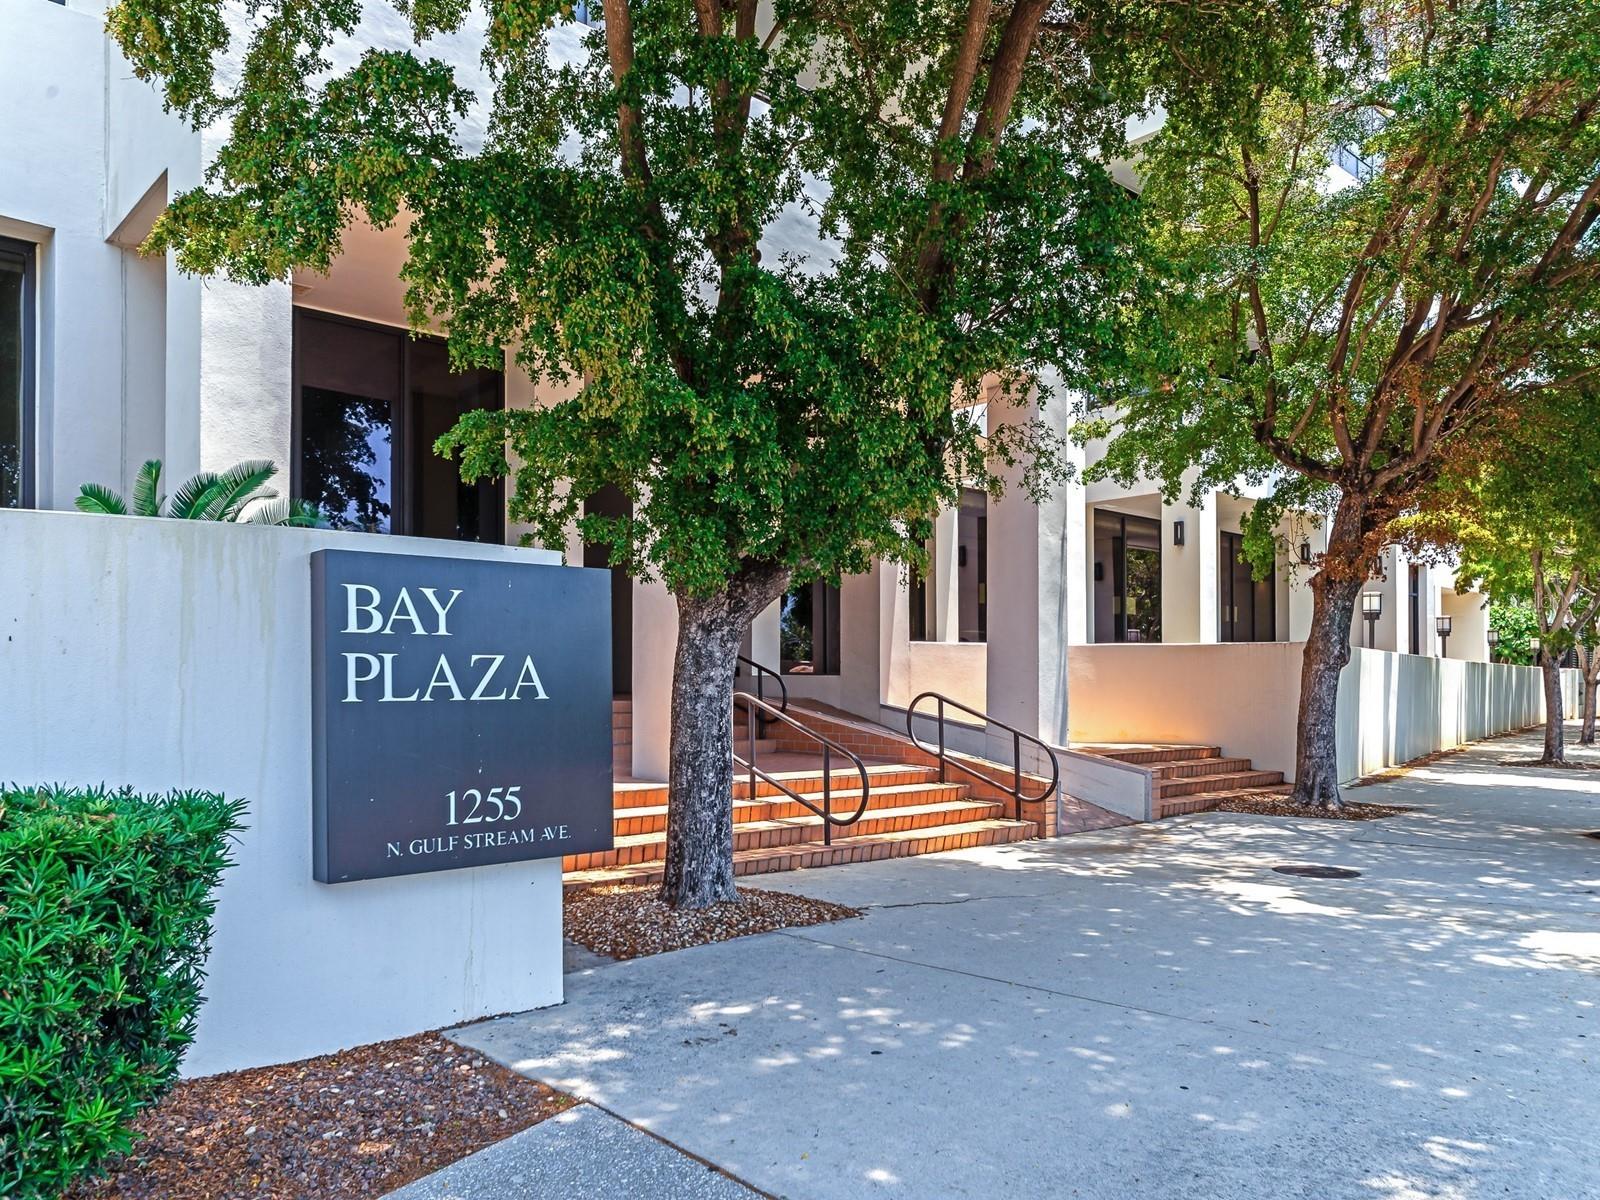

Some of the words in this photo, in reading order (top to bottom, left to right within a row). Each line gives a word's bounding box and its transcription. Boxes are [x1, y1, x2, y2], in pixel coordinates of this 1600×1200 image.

[340, 583, 463, 636] BAY
[341, 652, 550, 703] PLAZA
[445, 786, 522, 826] 1255
[386, 842, 403, 857] N.
[409, 836, 459, 855] GULF
[464, 828, 535, 849] STREAM
[540, 825, 571, 841] AVE.
